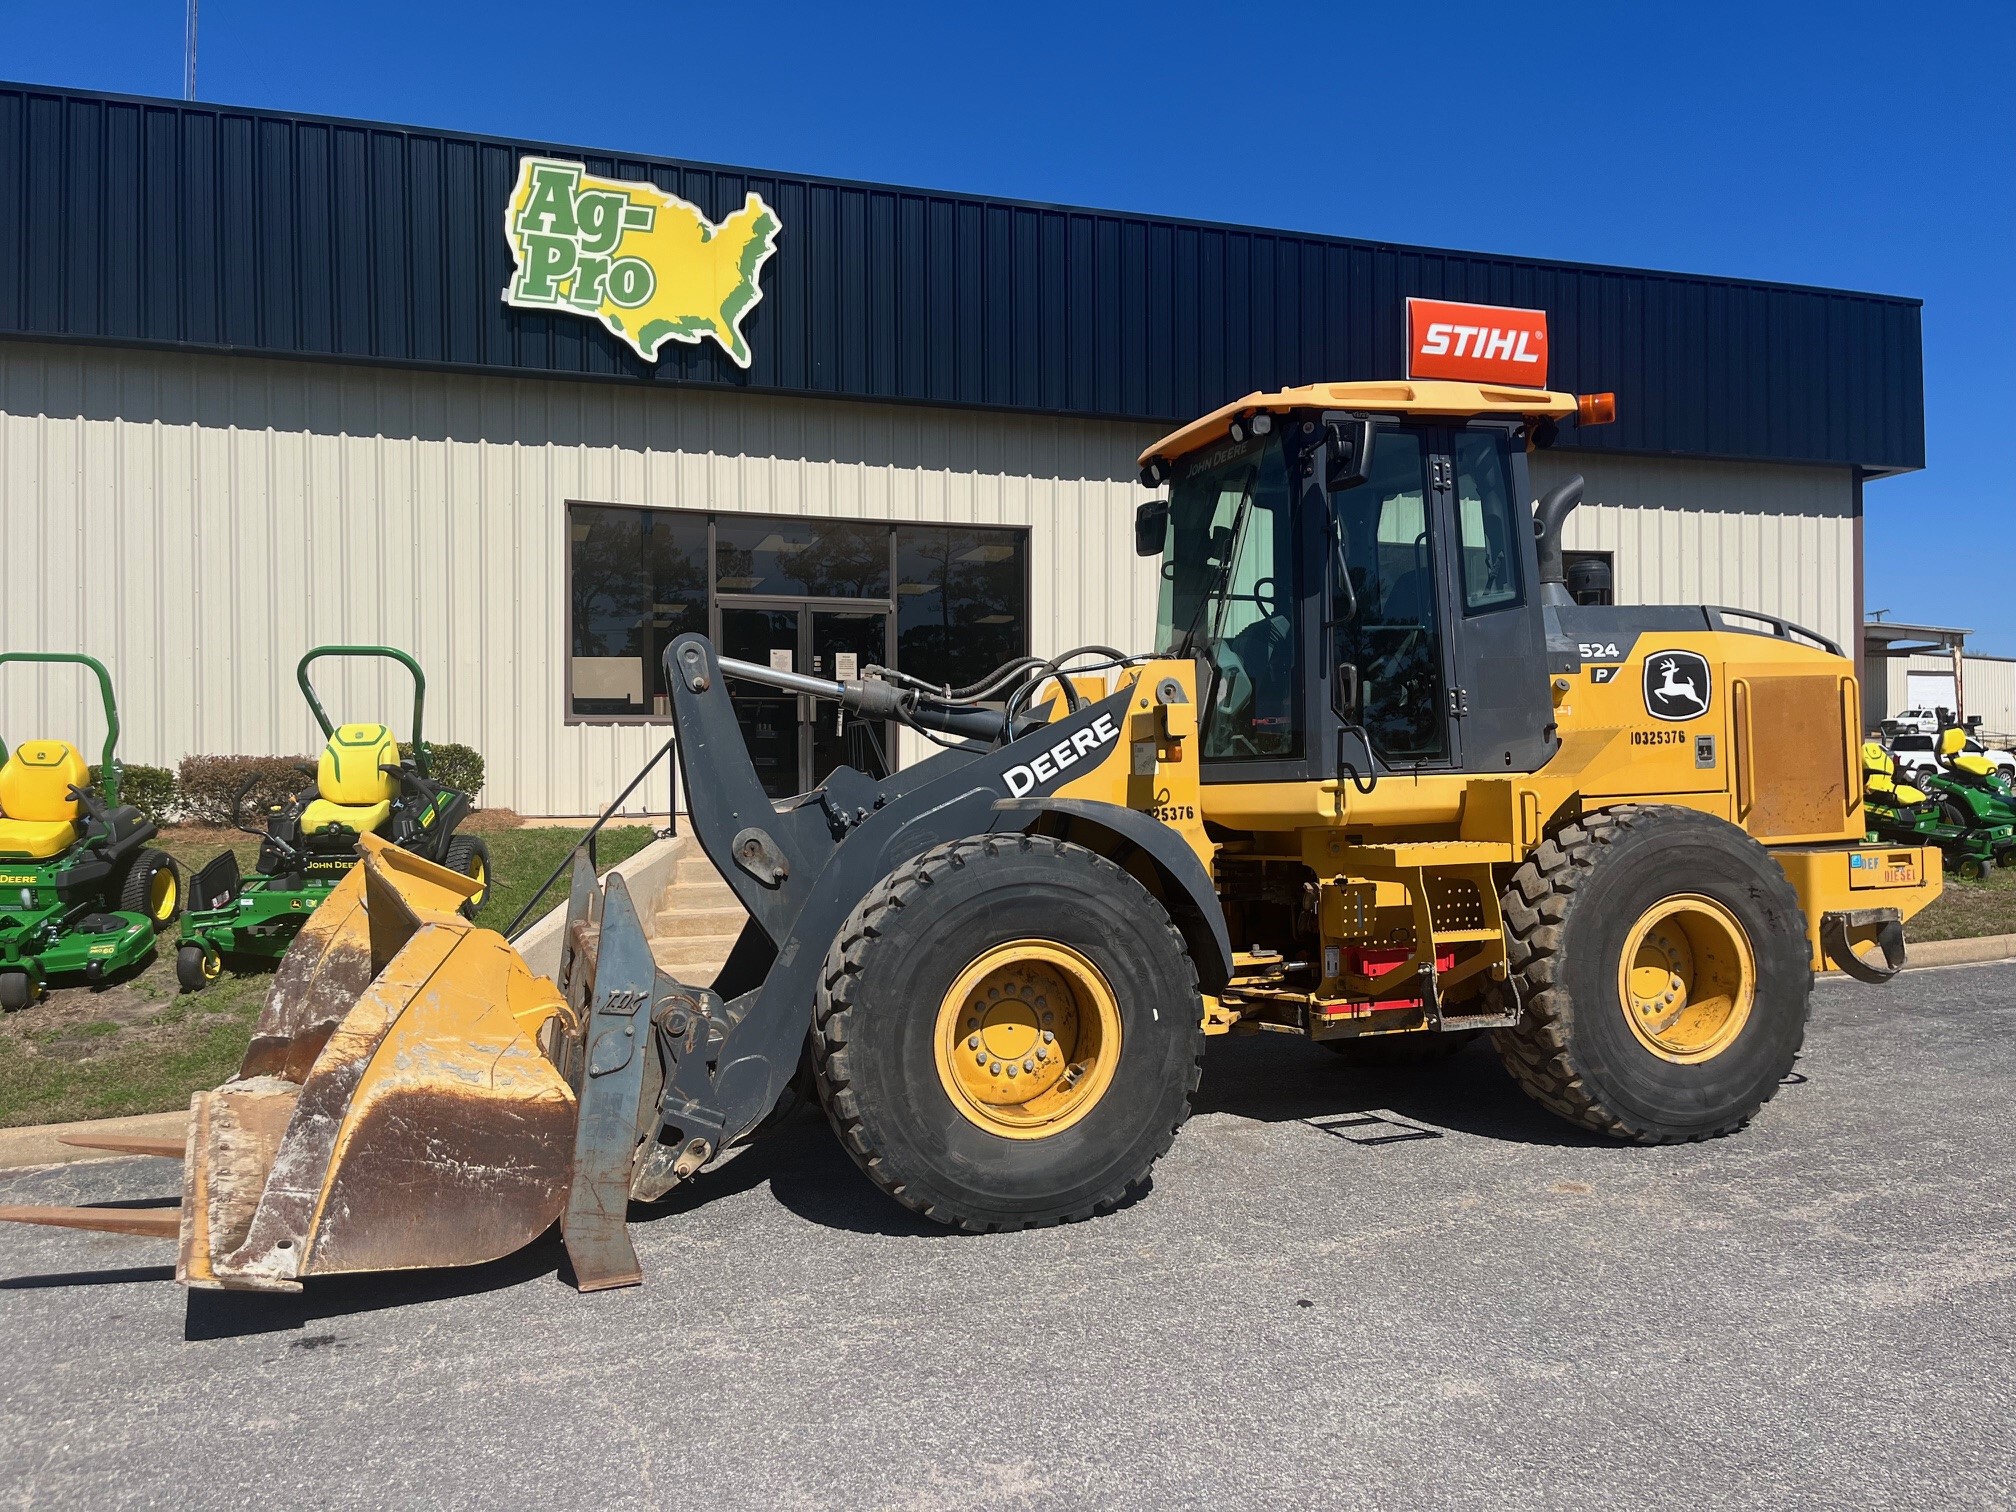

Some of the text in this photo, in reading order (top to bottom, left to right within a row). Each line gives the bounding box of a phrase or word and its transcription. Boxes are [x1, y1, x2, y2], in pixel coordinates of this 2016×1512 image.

[516, 163, 656, 255] Ag-
[515, 233, 656, 308] Pro
[1420, 322, 1540, 363] STIHL
[1186, 440, 1248, 479] JOHN DEERE
[1578, 642, 1620, 658] 524
[1595, 668, 1609, 682] P
[1630, 730, 1686, 746] 10325376
[1002, 712, 1120, 799] DEERE
[307, 861, 333, 869] JOHN
[1860, 857, 1880, 870] DEF
[0, 874, 37, 884] DEERE
[1883, 867, 1916, 883] DIESEL
